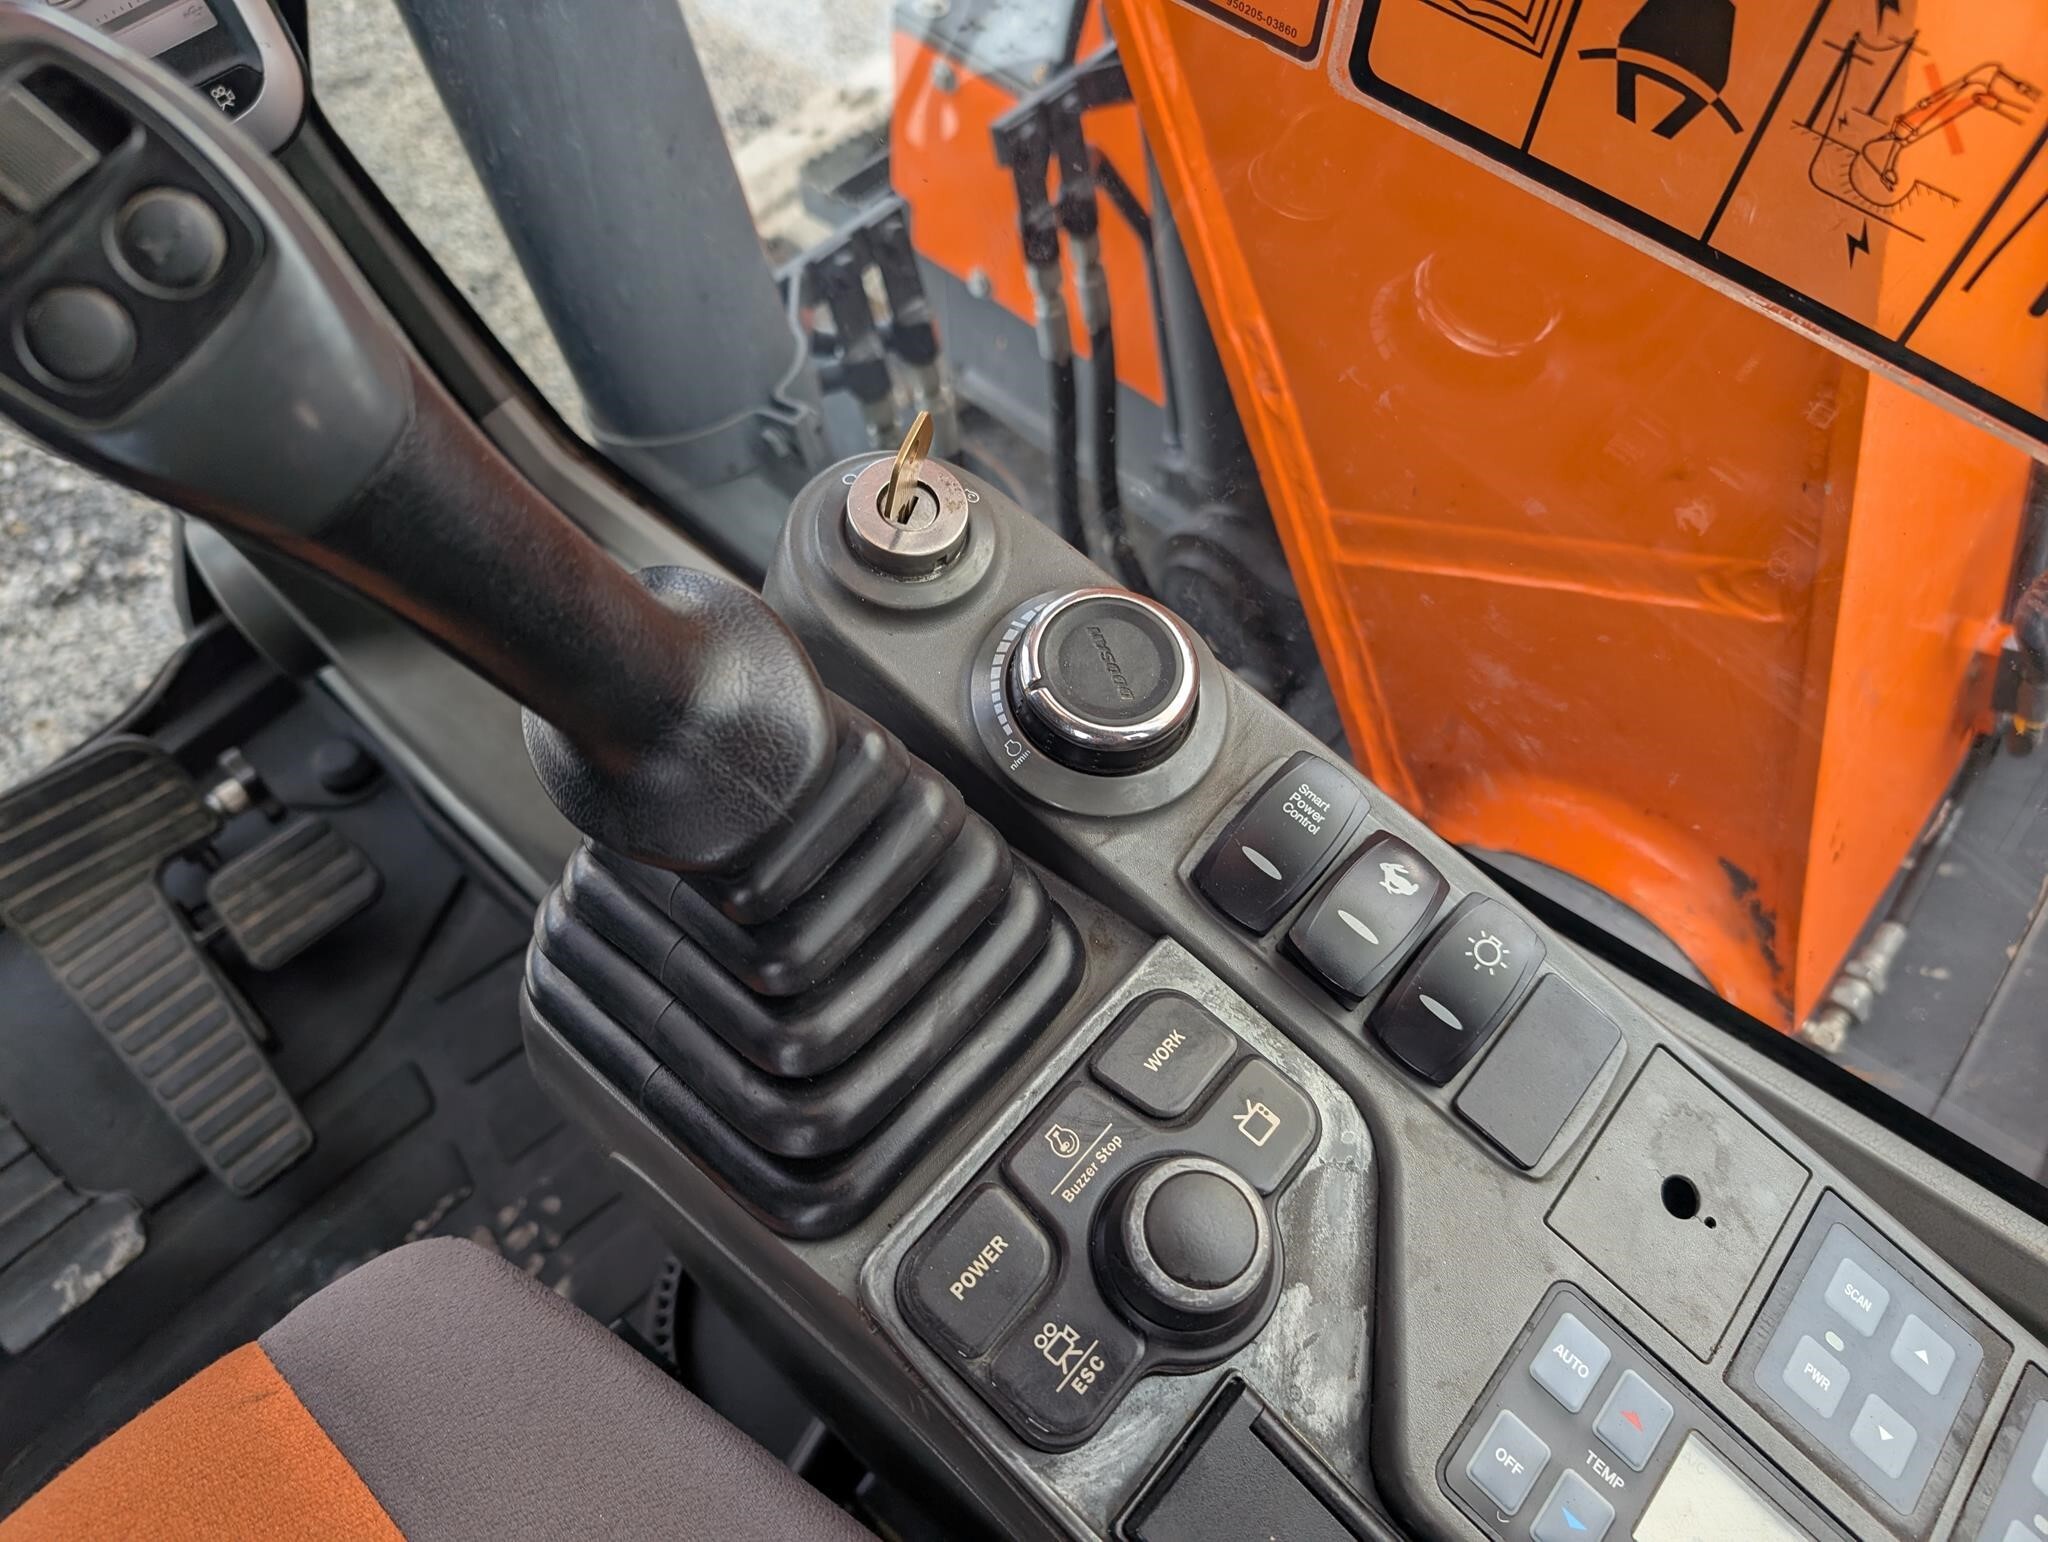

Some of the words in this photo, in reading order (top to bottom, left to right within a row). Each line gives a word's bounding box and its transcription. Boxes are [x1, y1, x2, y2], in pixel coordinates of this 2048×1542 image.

[1289, 792, 1325, 823] Power
[1298, 783, 1331, 812] Smart
[1282, 802, 1320, 835] Control
[1143, 1029, 1186, 1073] WORK
[1062, 1160, 1099, 1203] Buzzer
[1099, 1134, 1122, 1164] Stop
[949, 1235, 1009, 1301] POWER
[1844, 1283, 1872, 1312] SCAN
[1071, 1355, 1105, 1395] ESC
[1552, 1343, 1589, 1380] AUTO
[1803, 1362, 1831, 1391] PWR
[1494, 1447, 1524, 1476] OFF
[1585, 1449, 1625, 1490] TEMP
